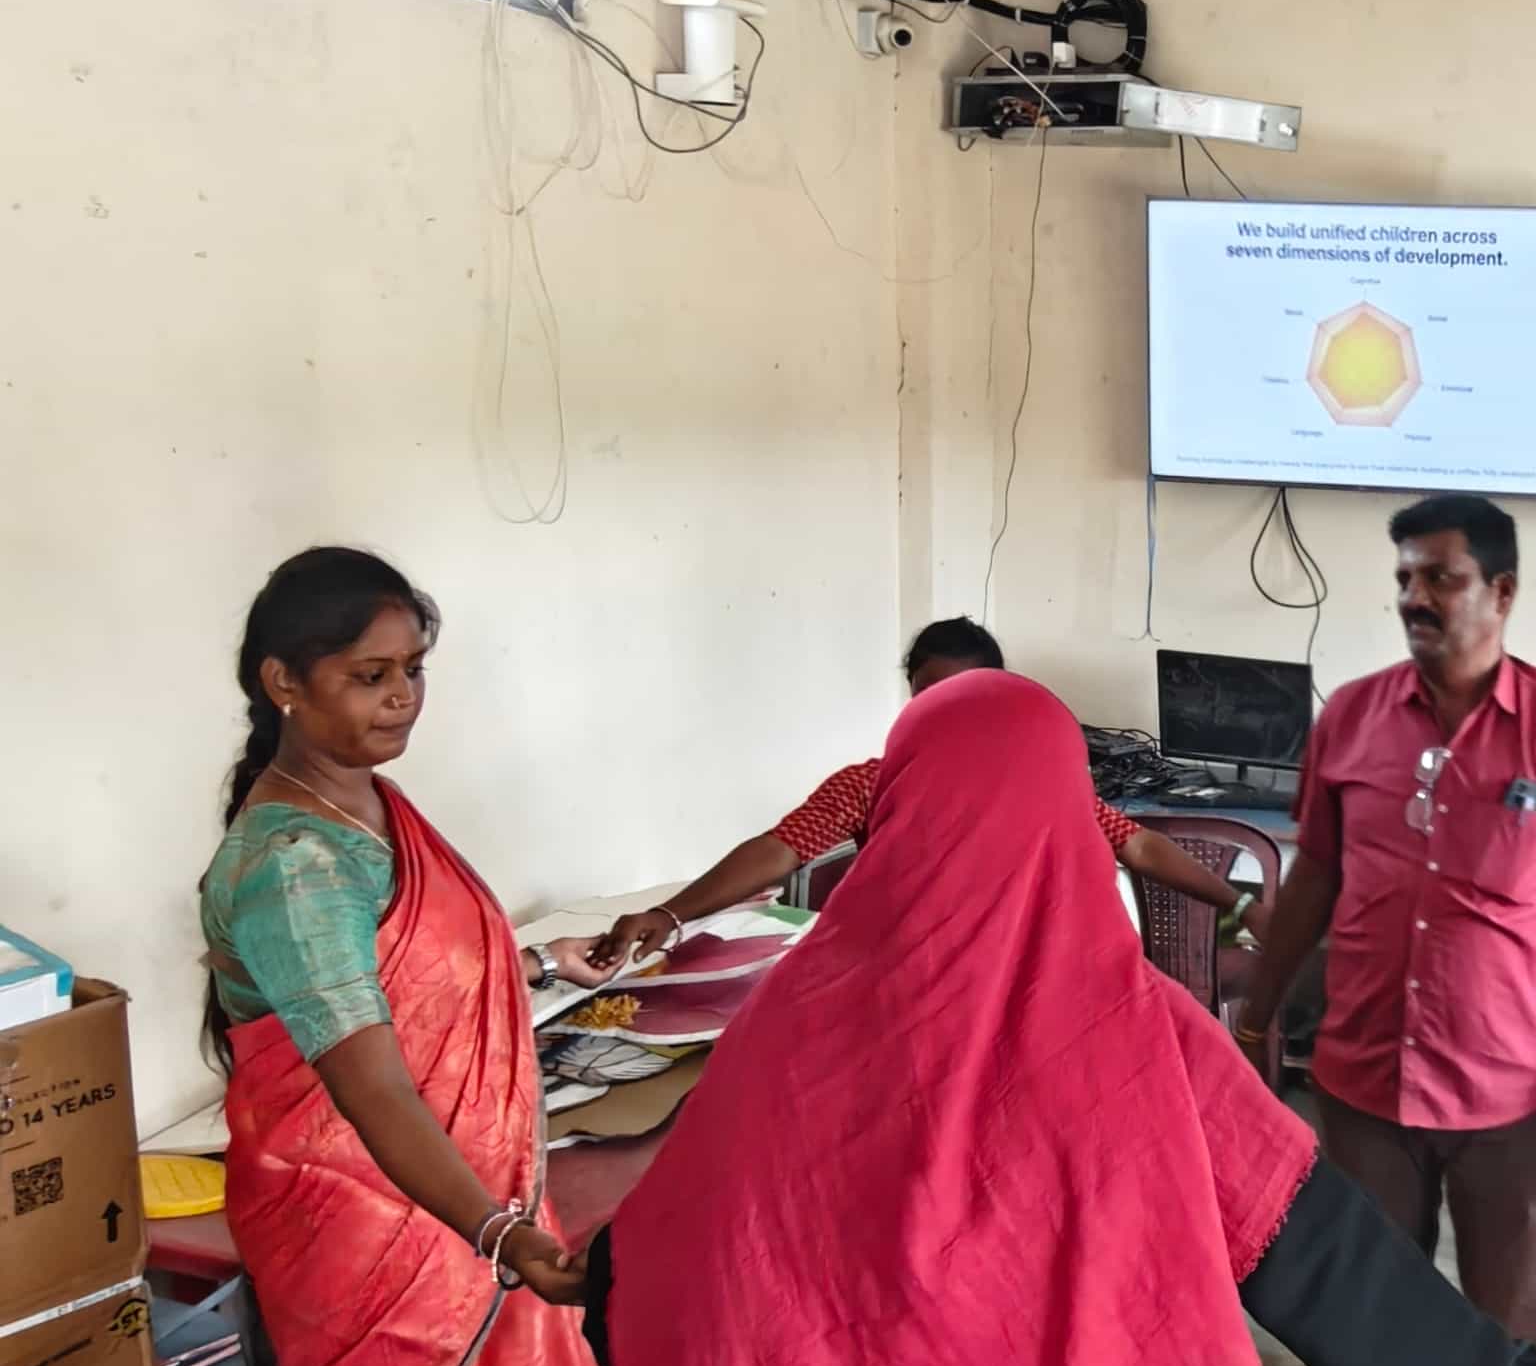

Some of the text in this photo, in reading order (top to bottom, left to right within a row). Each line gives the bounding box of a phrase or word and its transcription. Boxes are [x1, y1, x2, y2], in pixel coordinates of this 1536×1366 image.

[1236, 222, 1498, 244] We build unified children across
[1226, 243, 1509, 268] seven dimensions of development.
[22, 1108, 43, 1127] 14
[51, 1083, 117, 1118] YEARS
